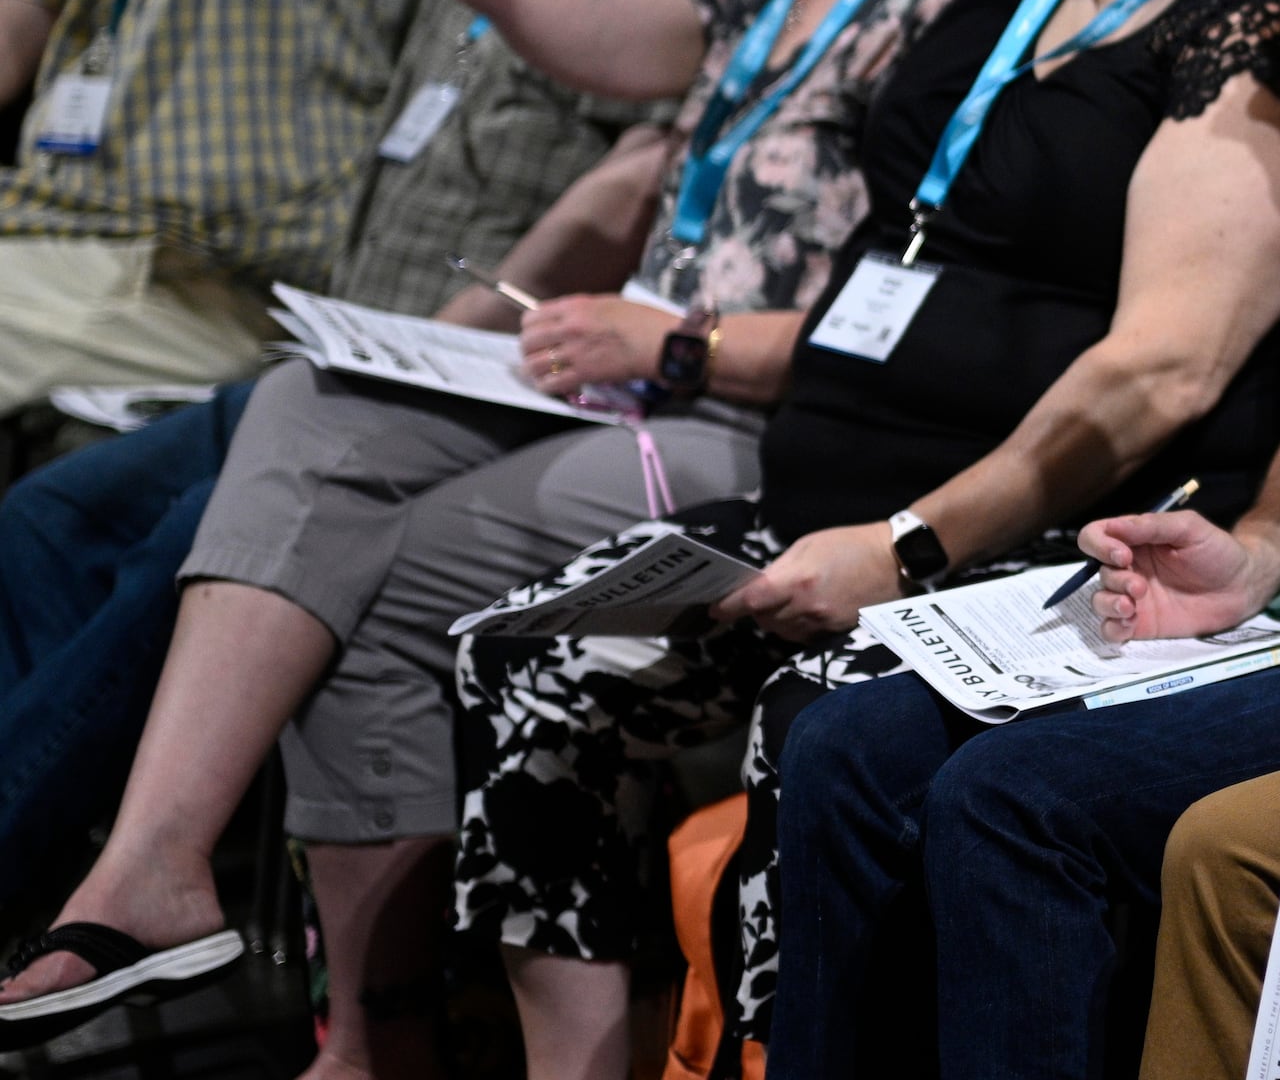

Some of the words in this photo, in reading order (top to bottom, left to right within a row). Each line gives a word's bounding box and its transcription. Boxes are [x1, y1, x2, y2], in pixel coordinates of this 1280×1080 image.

[576, 547, 694, 608] BULLETIN
[894, 608, 985, 686] BULLETIN
[1148, 683, 1162, 693] BOOK
[1162, 681, 1170, 690] OF
[1270, 1001, 1278, 1017] THE
